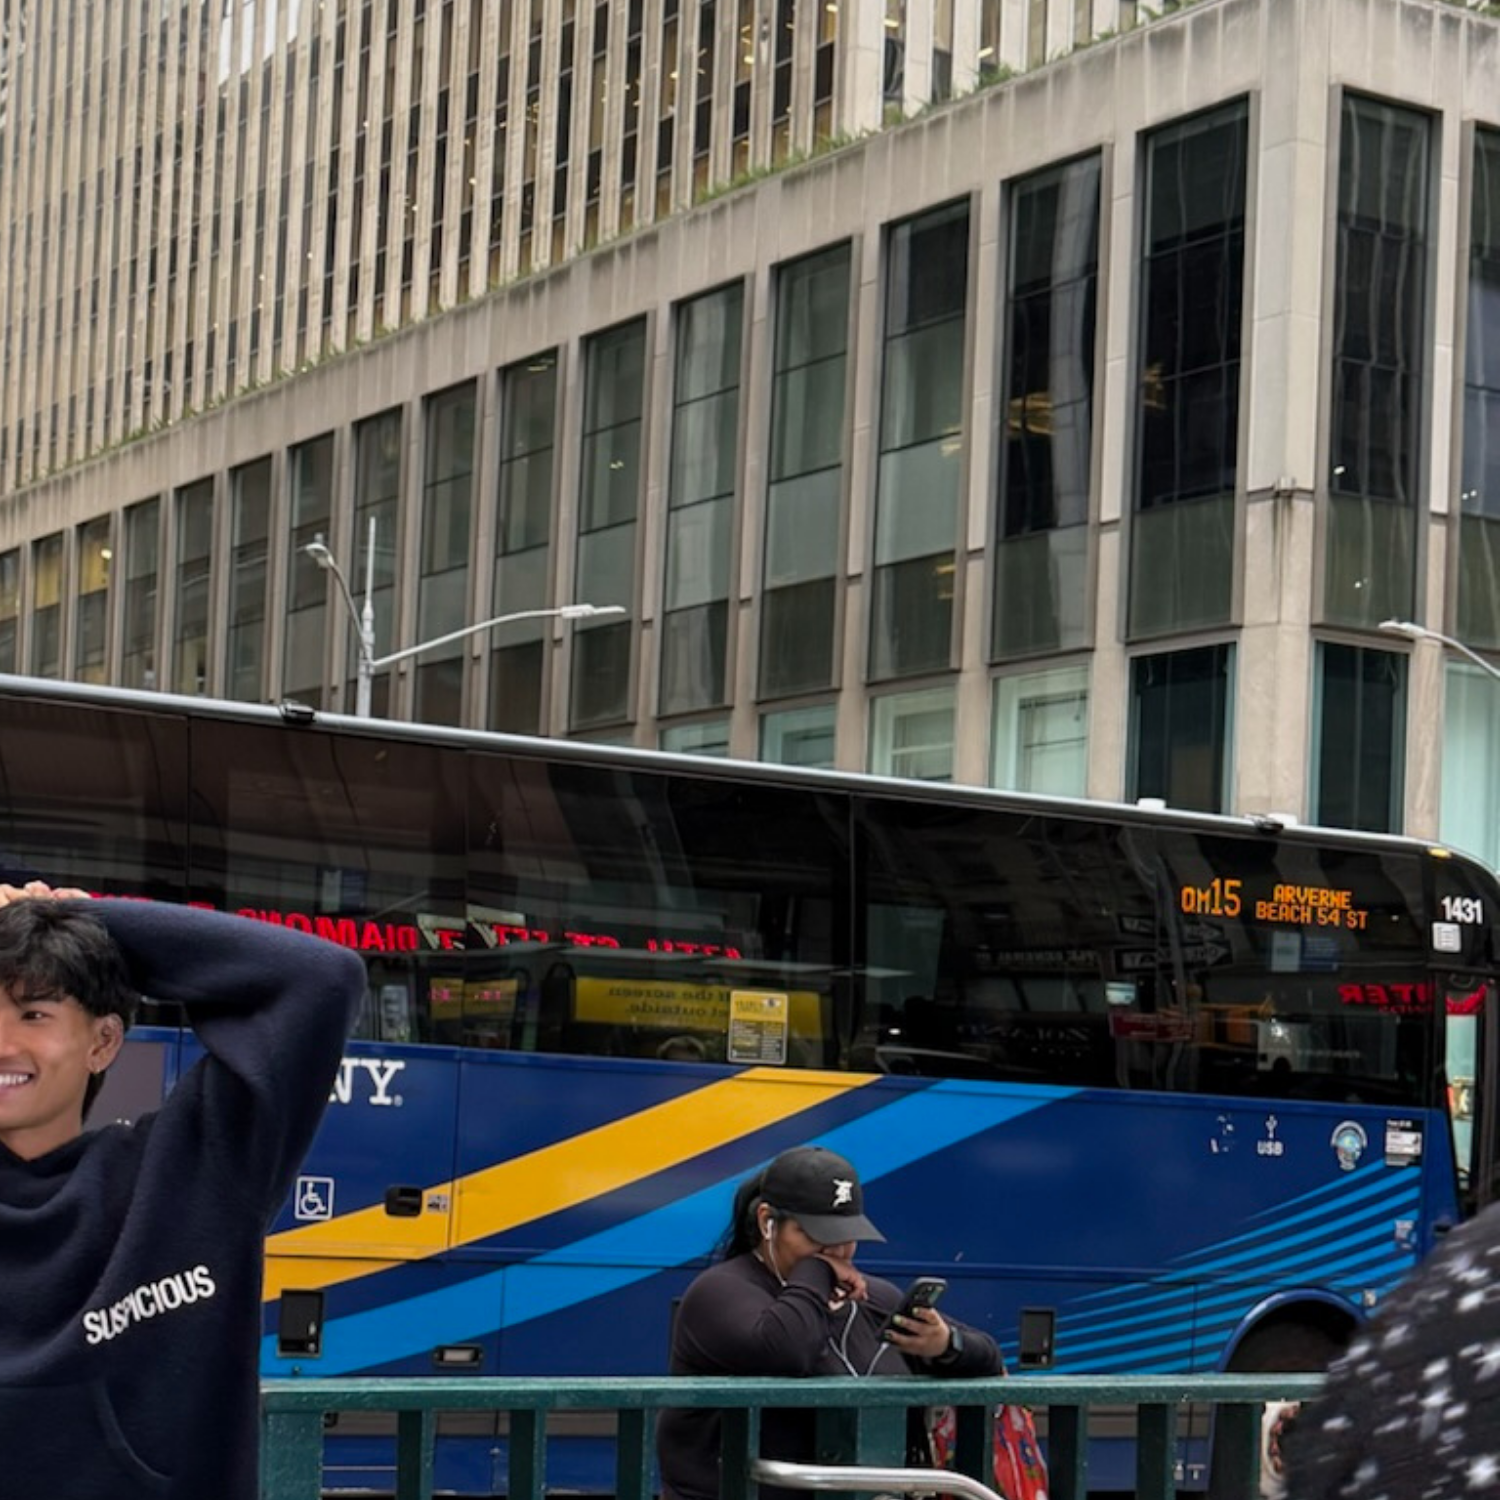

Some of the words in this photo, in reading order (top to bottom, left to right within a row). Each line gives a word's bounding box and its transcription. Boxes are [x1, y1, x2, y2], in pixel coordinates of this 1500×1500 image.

[1181, 877, 1242, 917] QM15
[1273, 884, 1352, 909] ARVERNE
[1441, 896, 1483, 924] 1431
[1256, 901, 1312, 925] BEACH
[1317, 905, 1340, 927] 54
[1346, 909, 1368, 929] ST
[1257, 1141, 1284, 1156] USB
[82, 1264, 216, 1344] SUSPICIOUS
